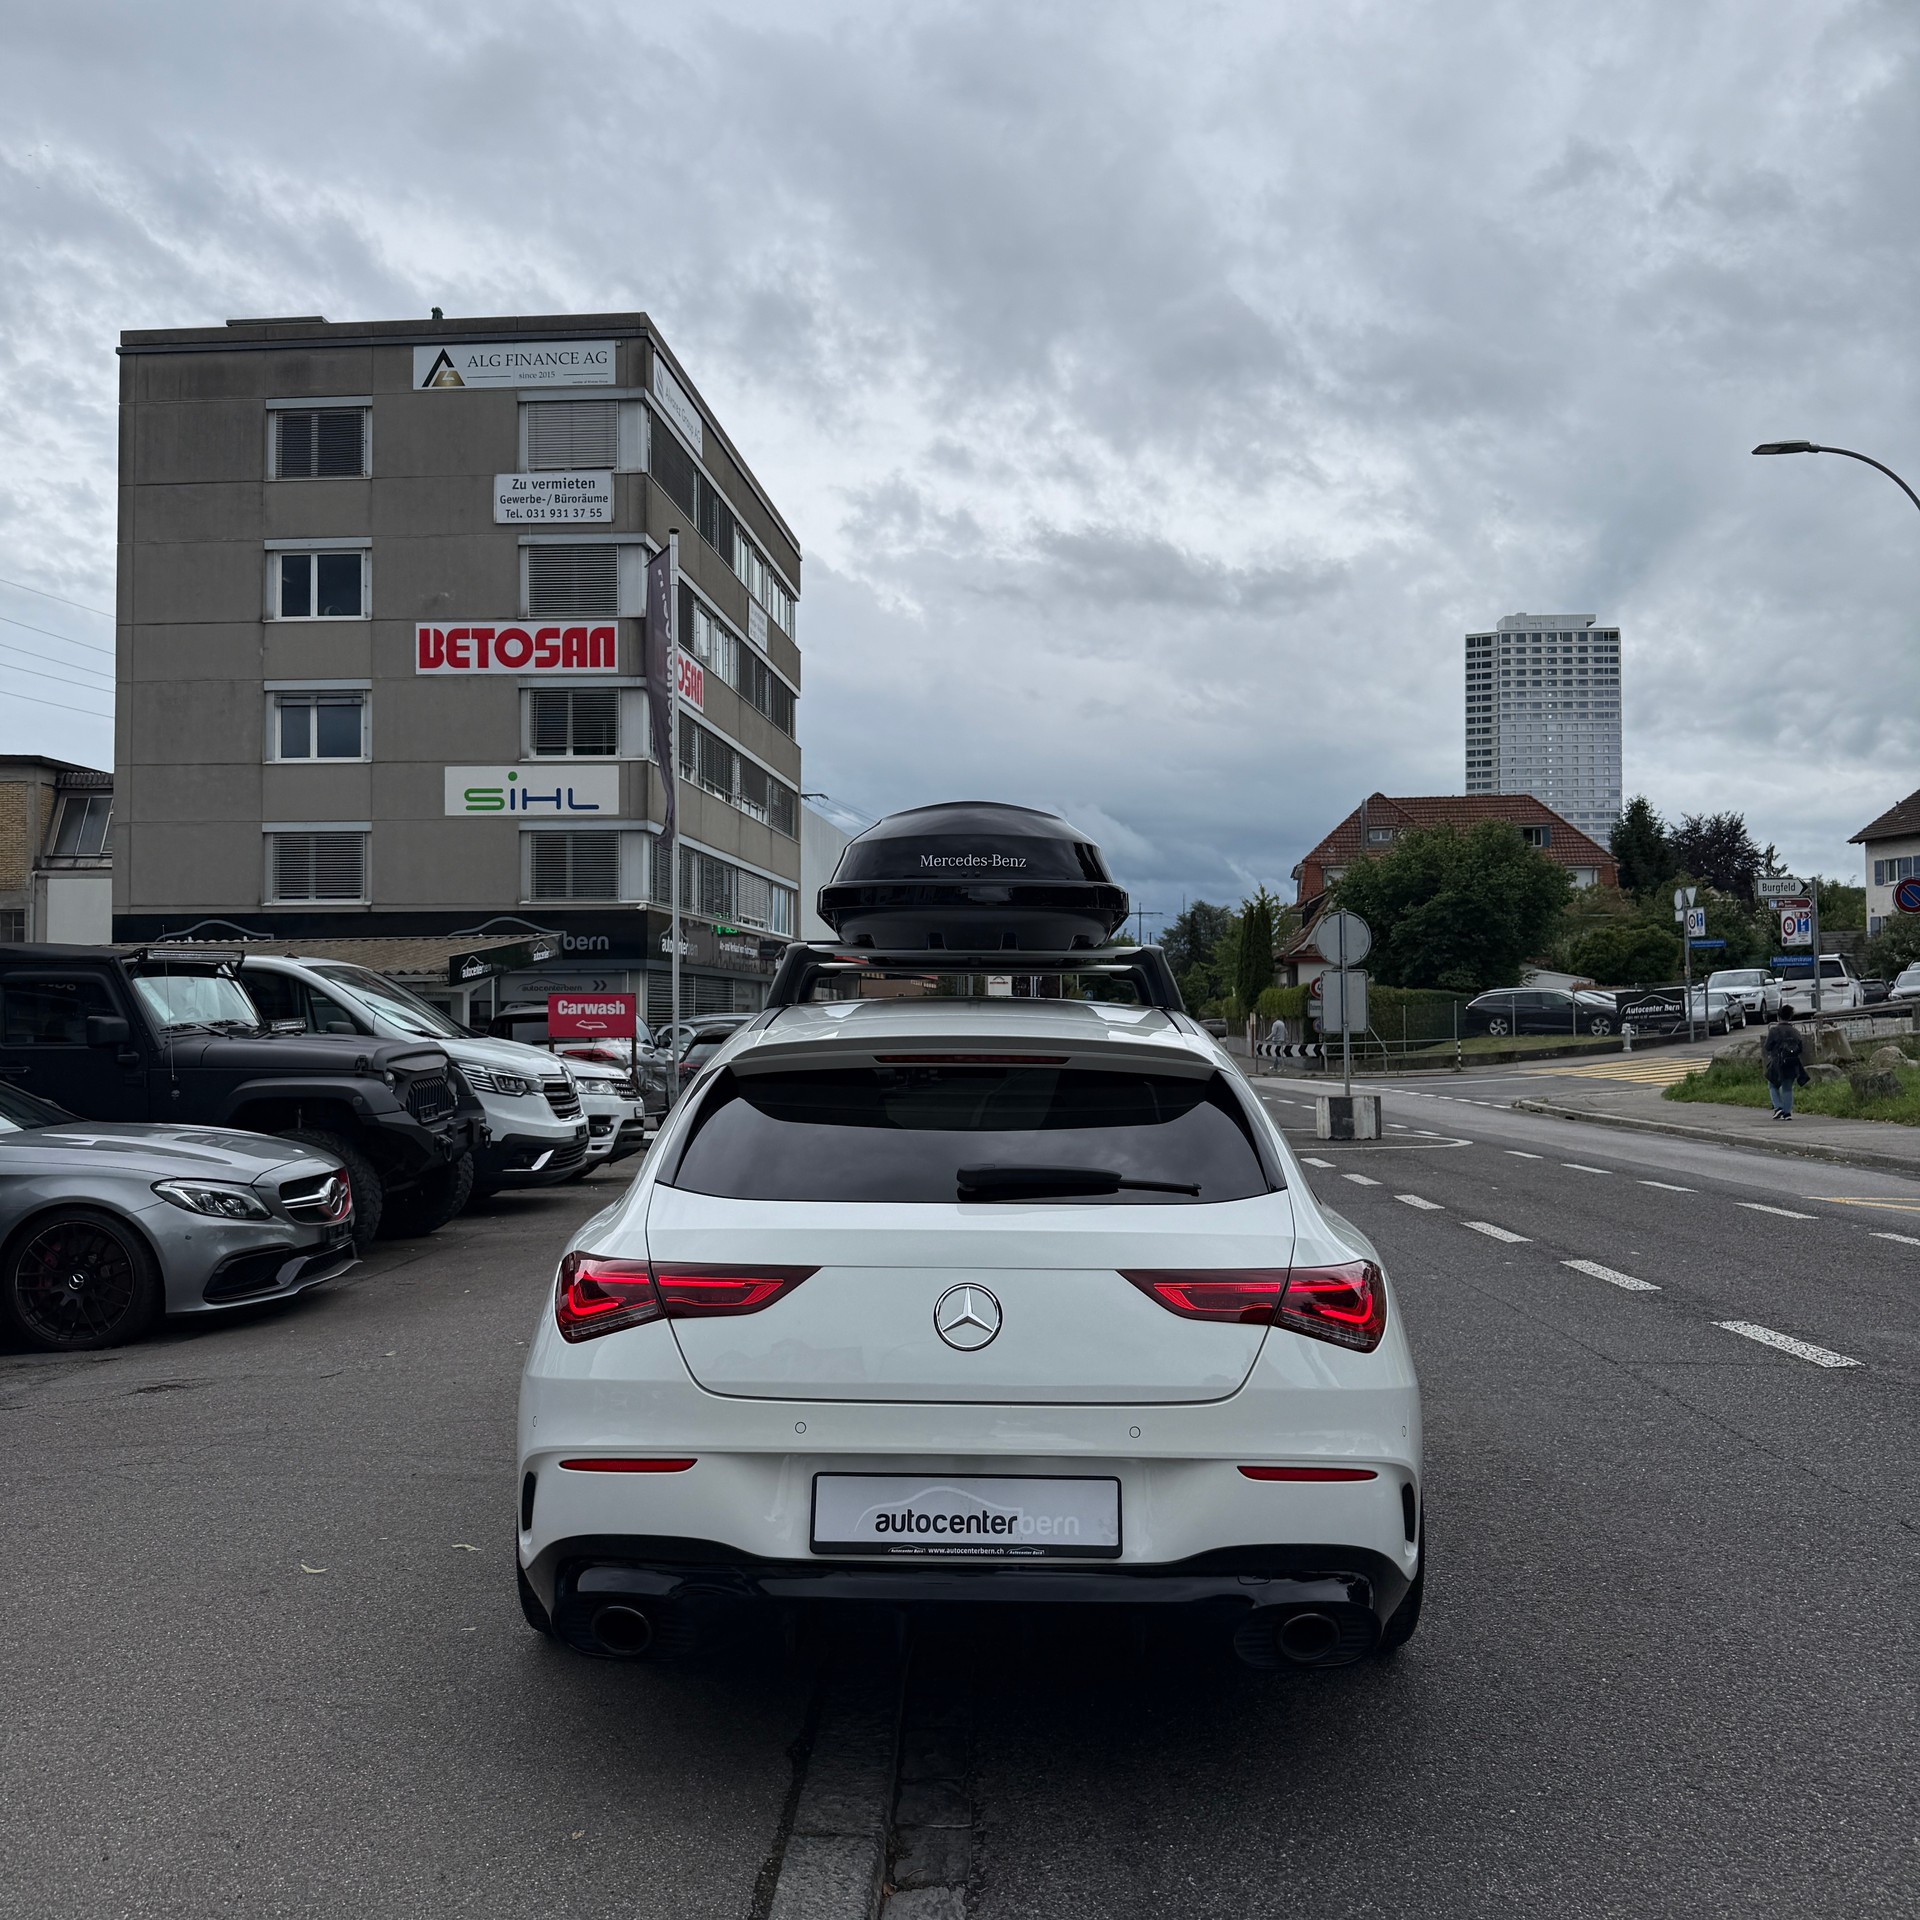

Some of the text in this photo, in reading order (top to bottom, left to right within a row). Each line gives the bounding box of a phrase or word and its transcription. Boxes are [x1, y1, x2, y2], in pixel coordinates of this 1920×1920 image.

[467, 351, 608, 368] ALG FINANCE AG
[538, 371, 556, 379] 2015
[512, 477, 595, 490] Zu vermieten
[554, 493, 609, 504] Büroräume
[505, 507, 603, 519] Tel. 031 931 37 55
[418, 626, 616, 669] BETOSAN
[678, 654, 703, 708] OSAN
[920, 854, 1027, 868] Mercedes-Benz
[1762, 882, 1796, 894] Burgfeld
[557, 1000, 626, 1016] Carwash
[1625, 1004, 1681, 1014] Autocenter Bern
[928, 1547, 1005, 1555] www.autocenterbern.ch
